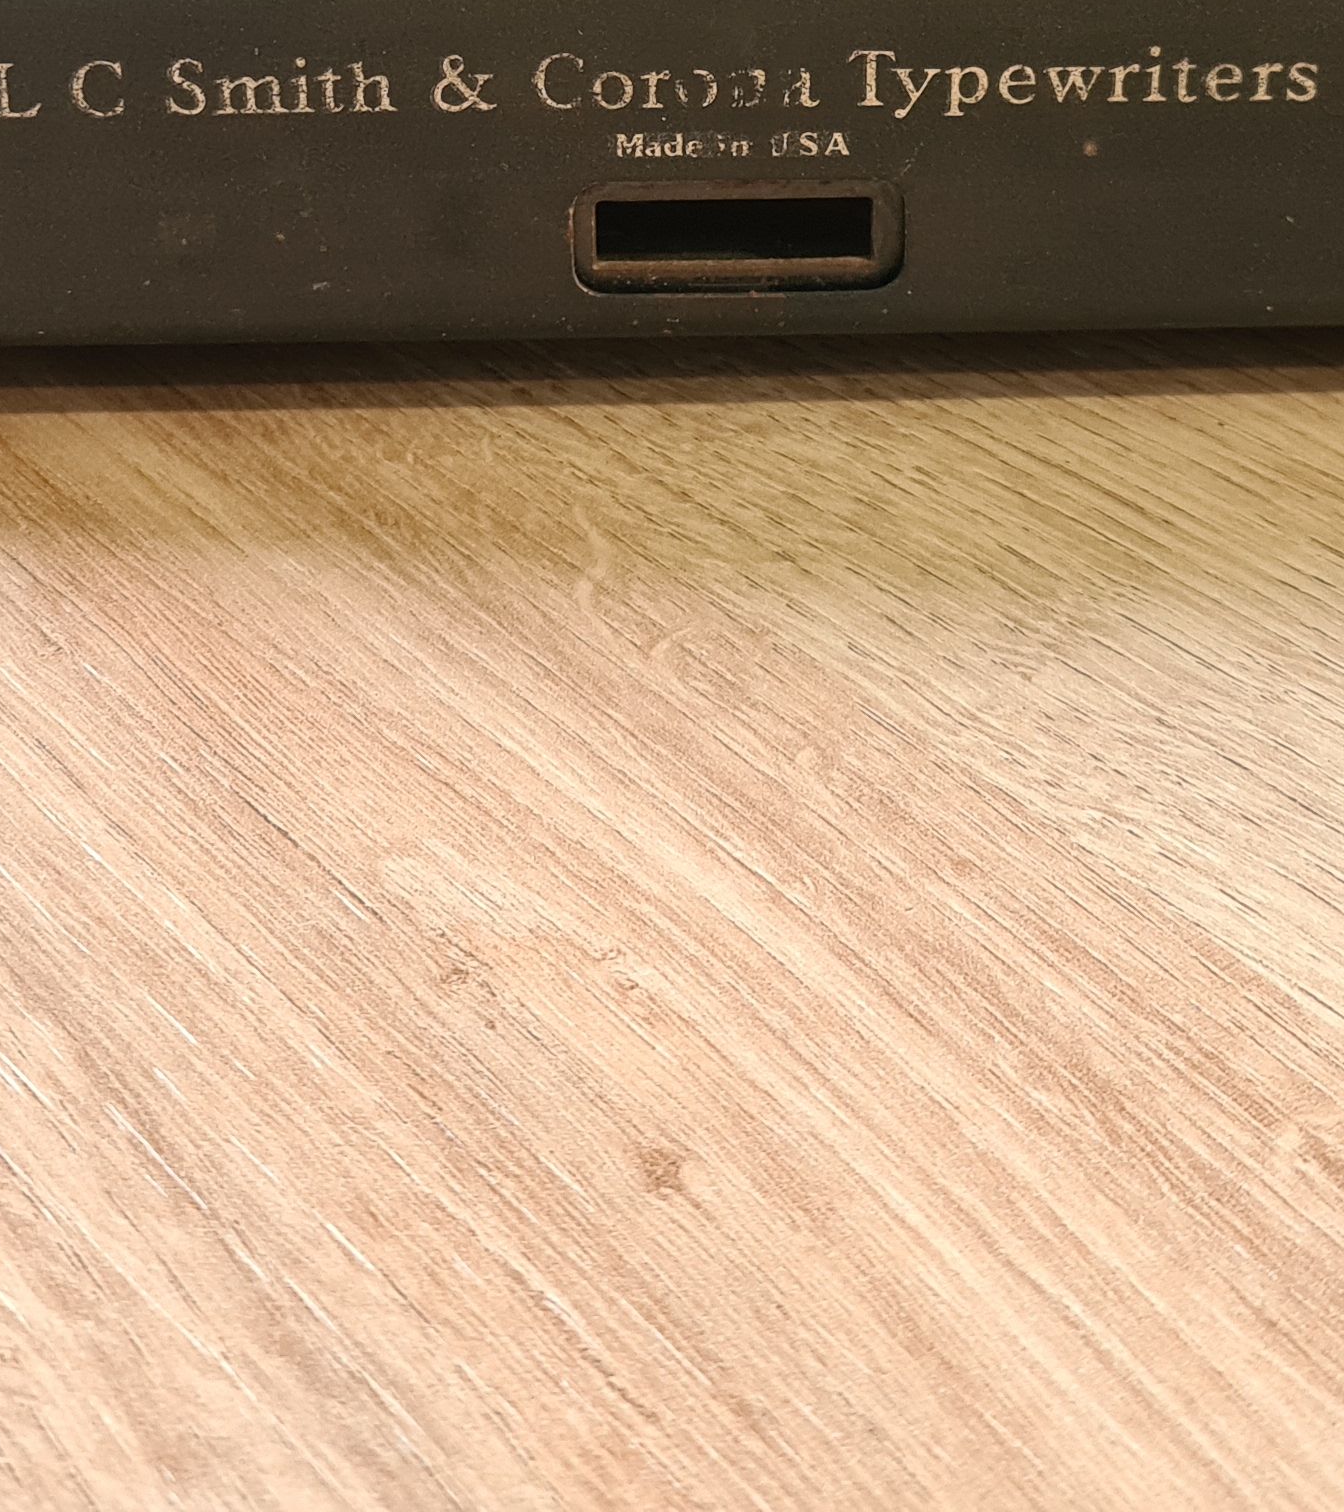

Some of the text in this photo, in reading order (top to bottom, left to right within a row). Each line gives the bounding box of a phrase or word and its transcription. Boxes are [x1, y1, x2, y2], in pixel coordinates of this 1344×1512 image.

[68, 59, 127, 119] C
[164, 56, 399, 117] Smith
[431, 53, 498, 114] &
[847, 45, 1319, 120] Typewriters
[614, 132, 704, 159] Made
